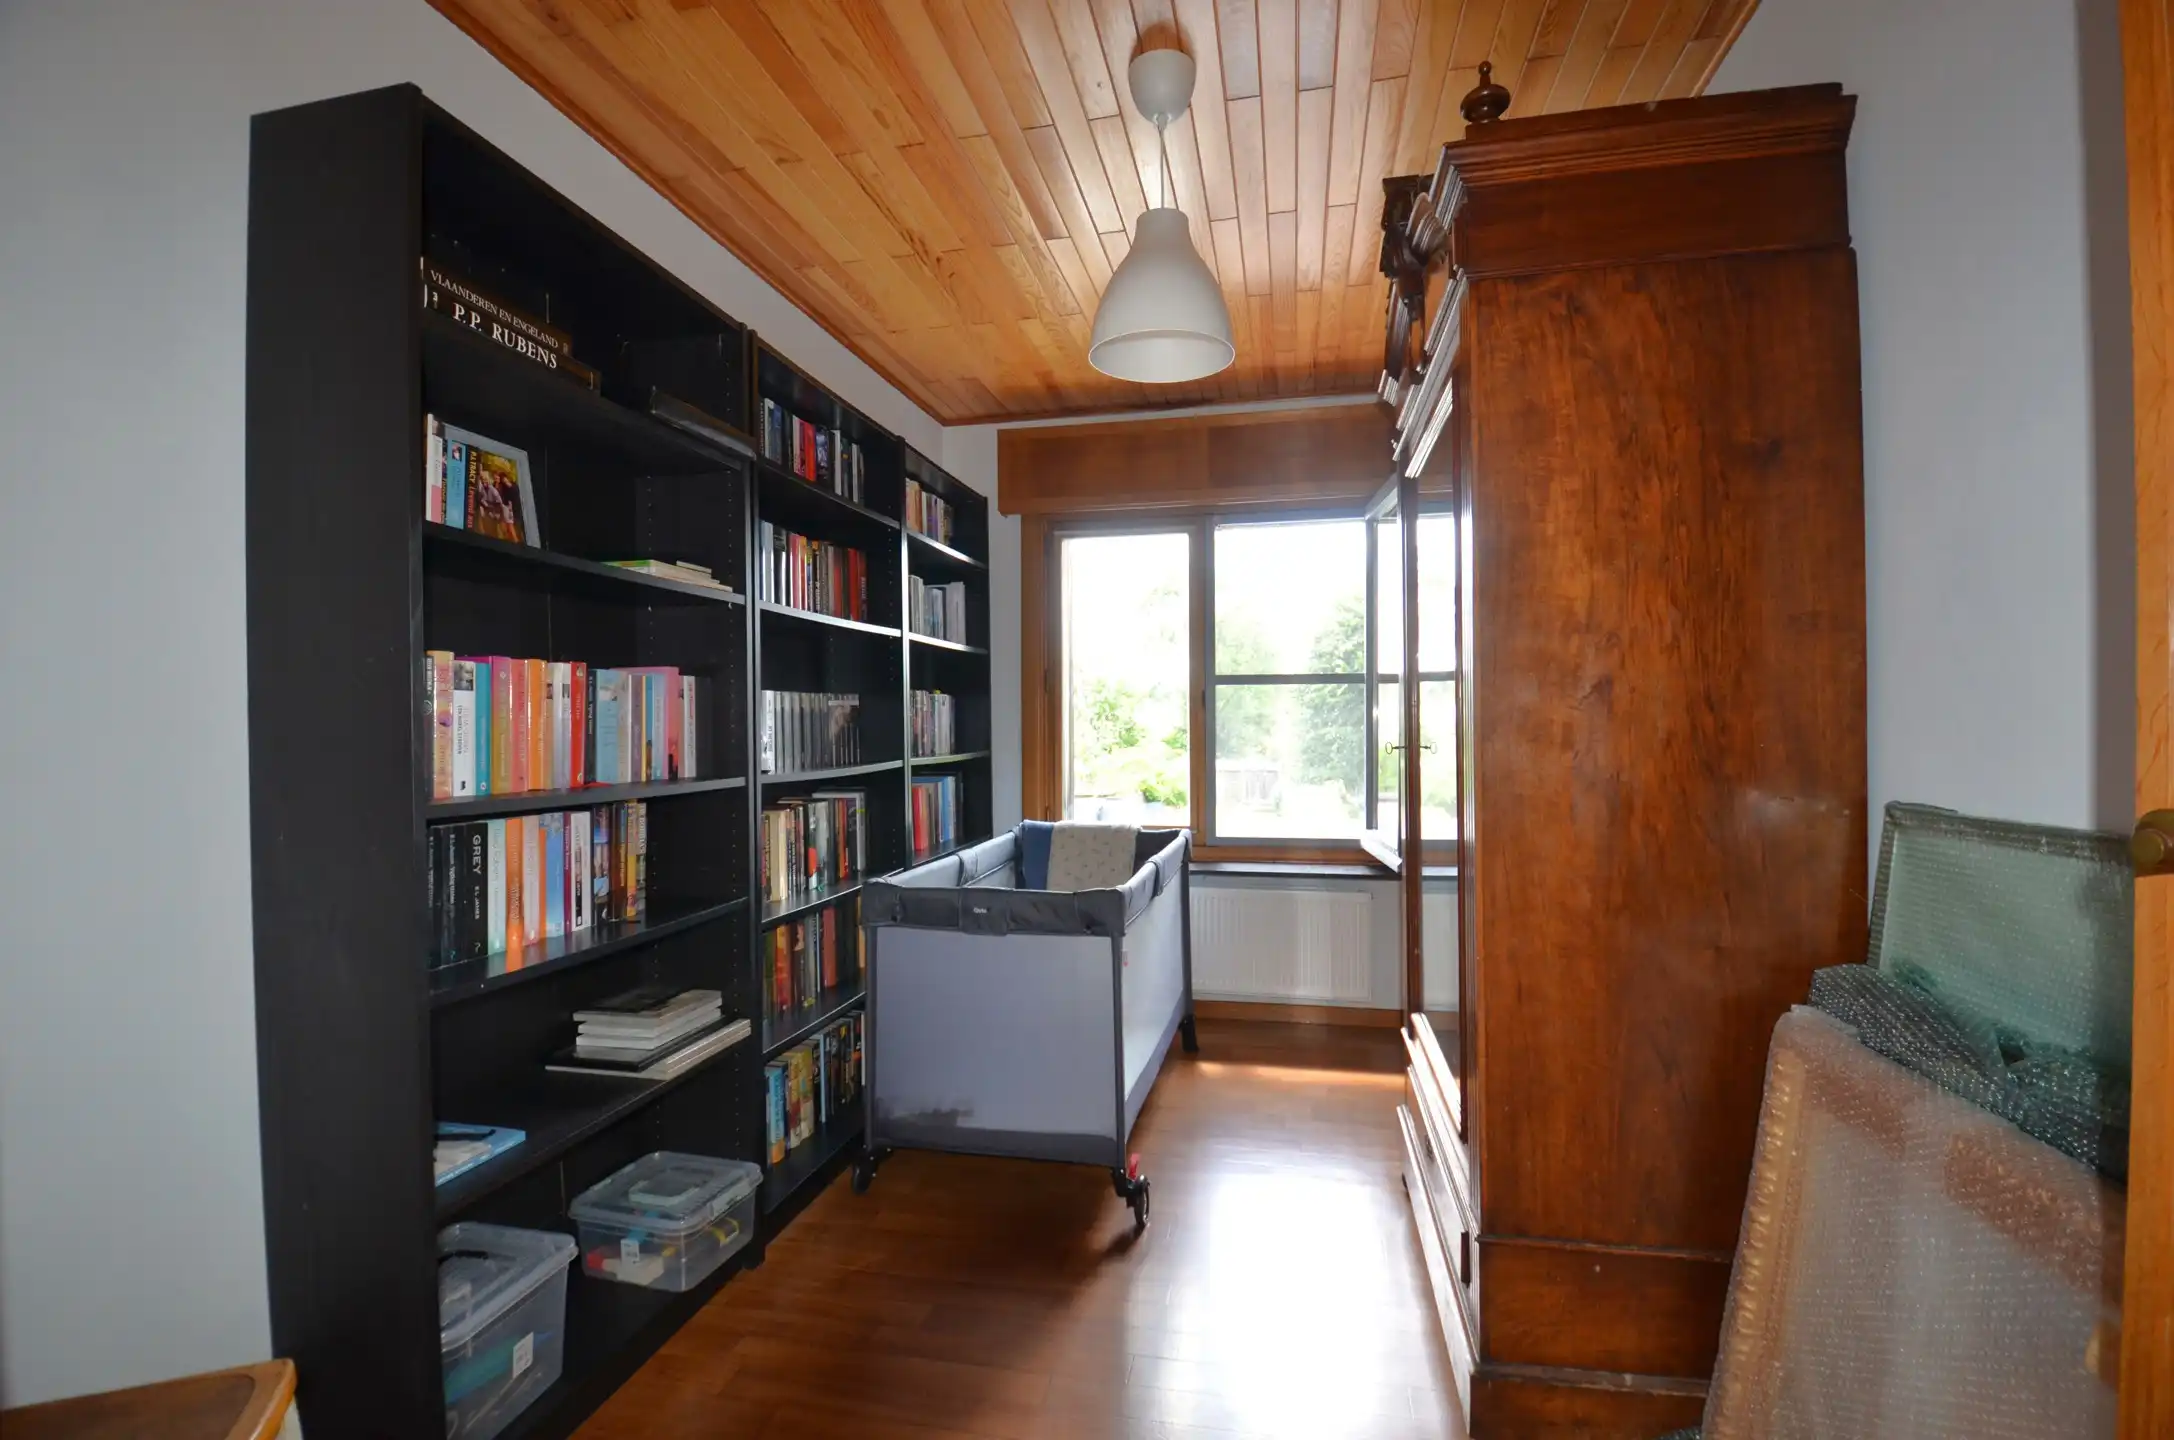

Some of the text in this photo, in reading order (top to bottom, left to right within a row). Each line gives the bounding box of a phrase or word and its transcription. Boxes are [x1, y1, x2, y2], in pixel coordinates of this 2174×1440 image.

[431, 269, 559, 349] VLAANDEREN EN ENGELAND
[453, 302, 557, 369] P.P. RUBENS
[469, 461, 477, 484] TRACY
[472, 834, 482, 875] GREY
